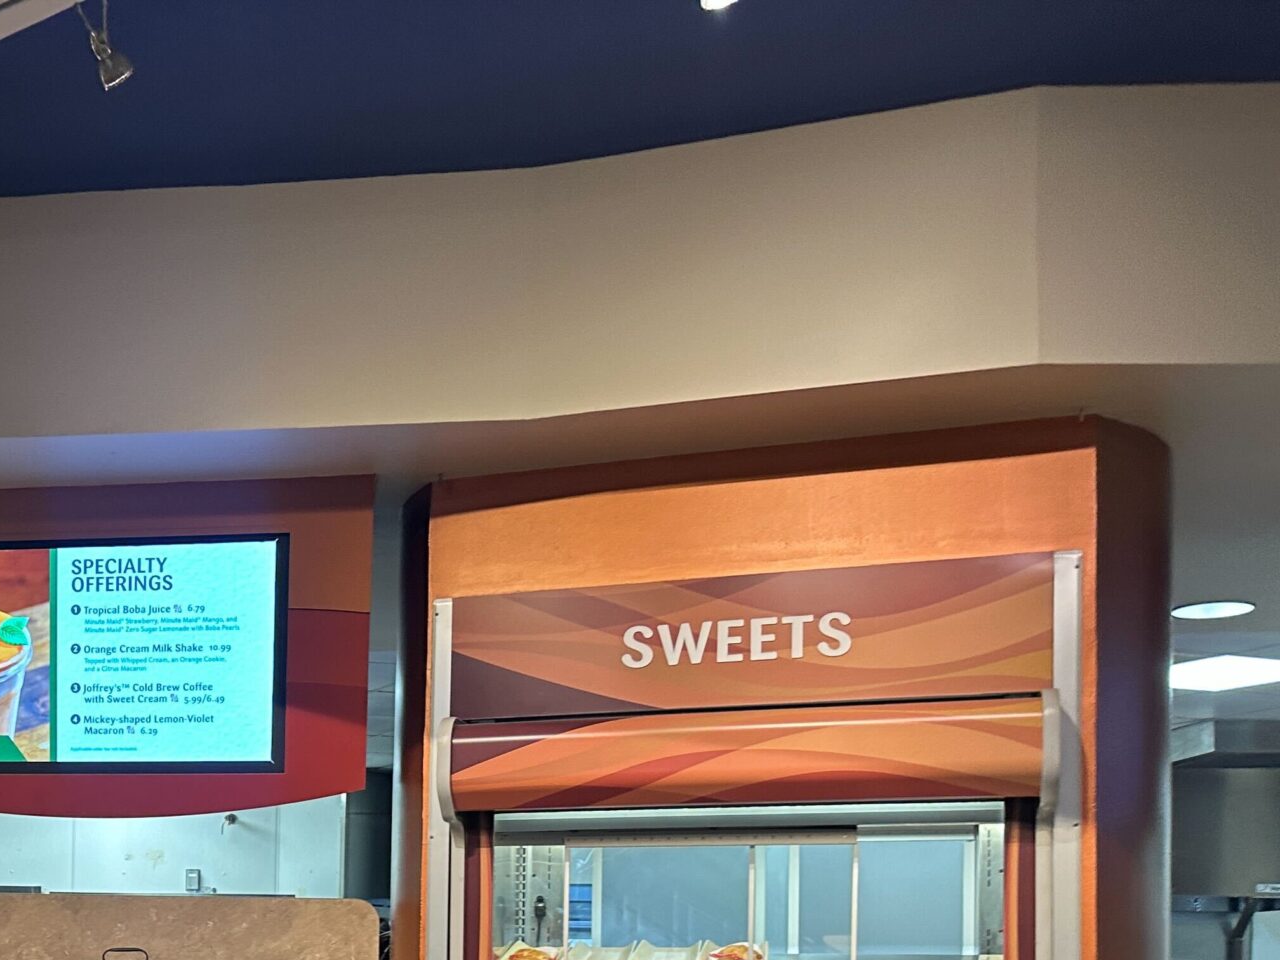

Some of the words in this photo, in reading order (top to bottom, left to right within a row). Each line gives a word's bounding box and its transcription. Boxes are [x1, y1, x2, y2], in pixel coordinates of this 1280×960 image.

[71, 557, 167, 575] SPECIALTY
[71, 575, 173, 592] OFFERINGS
[84, 605, 120, 616] Tropical
[123, 605, 146, 614] Boba
[148, 605, 170, 615] Juice
[188, 604, 205, 613] 6.79
[622, 611, 852, 668] SWEETS
[84, 645, 116, 655] Orange
[120, 645, 149, 653] Cream
[152, 644, 172, 652] Milk
[175, 644, 203, 652] Shake
[210, 644, 231, 652] 10.99
[133, 683, 153, 692] Cold
[156, 683, 180, 691] Brew
[183, 682, 213, 691] Coffee
[84, 695, 104, 703] with
[107, 695, 135, 703] Sweet
[137, 694, 167, 703] Cream
[184, 695, 225, 704] 5.99/6.49
[84, 715, 151, 726] Mickey-shaped
[154, 715, 214, 723] Lemon-Violet
[84, 726, 124, 734] Macaron
[140, 727, 157, 735] 6.29
